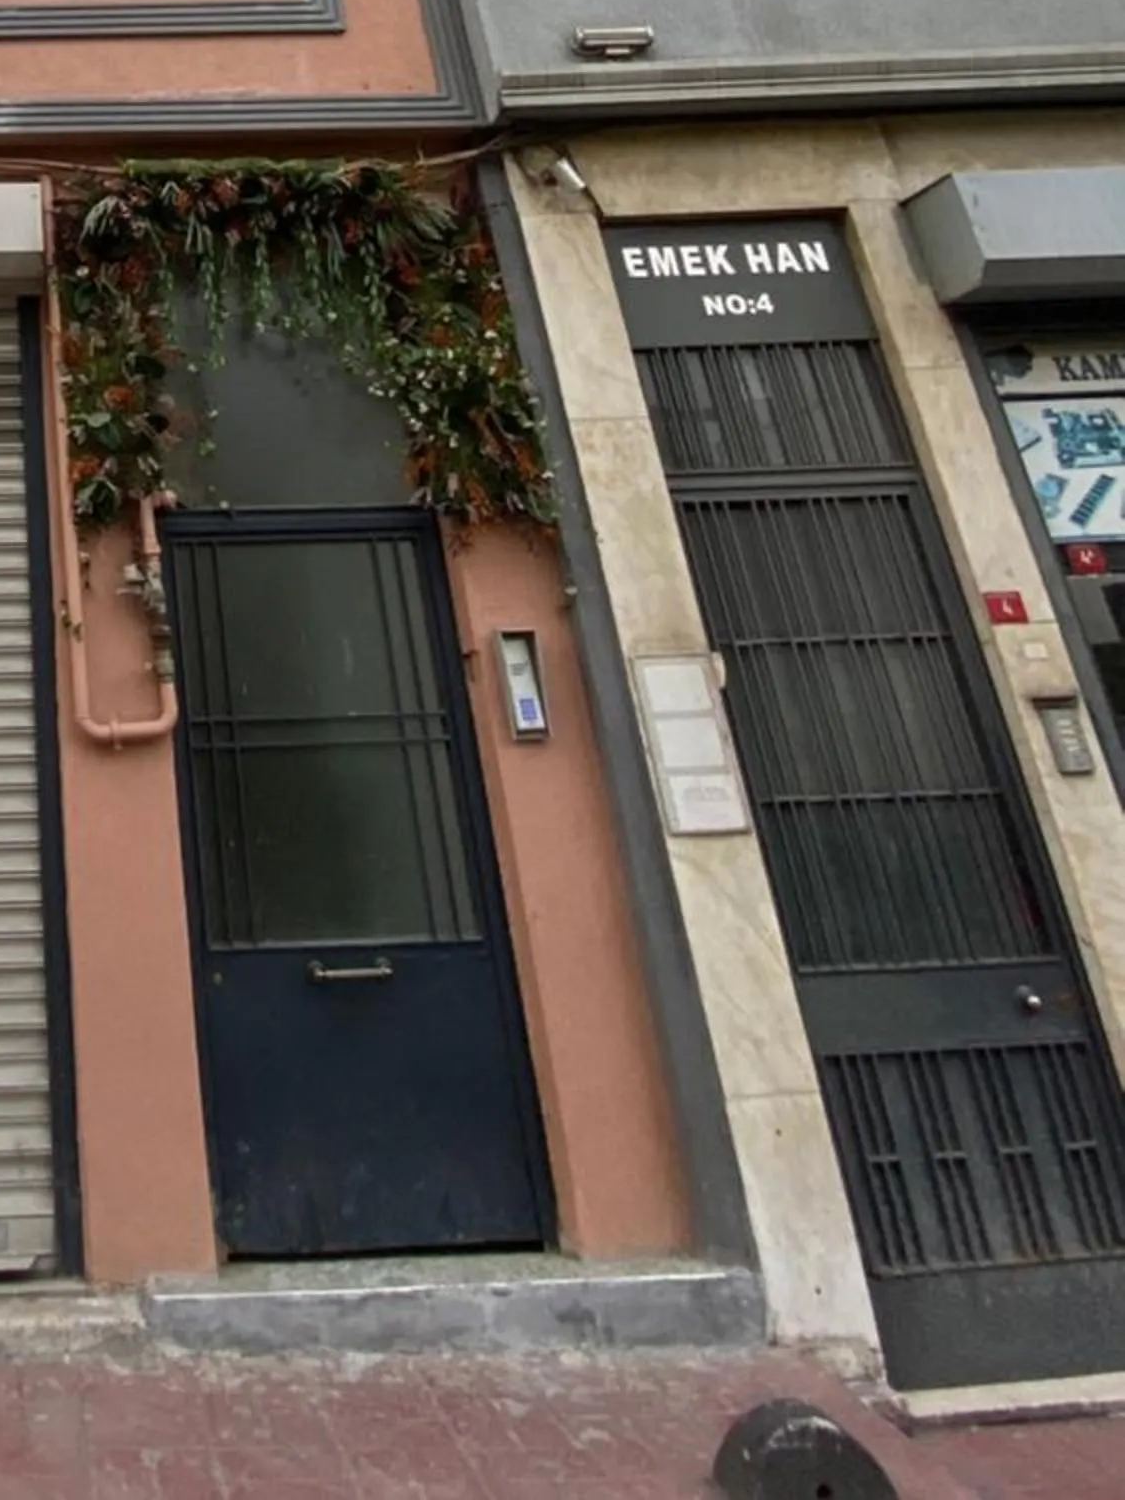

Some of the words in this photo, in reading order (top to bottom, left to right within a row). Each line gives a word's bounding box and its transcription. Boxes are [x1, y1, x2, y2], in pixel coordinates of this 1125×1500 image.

[622, 245, 736, 278] EMEK
[743, 241, 831, 274] HAN
[701, 292, 774, 316] NO:4
